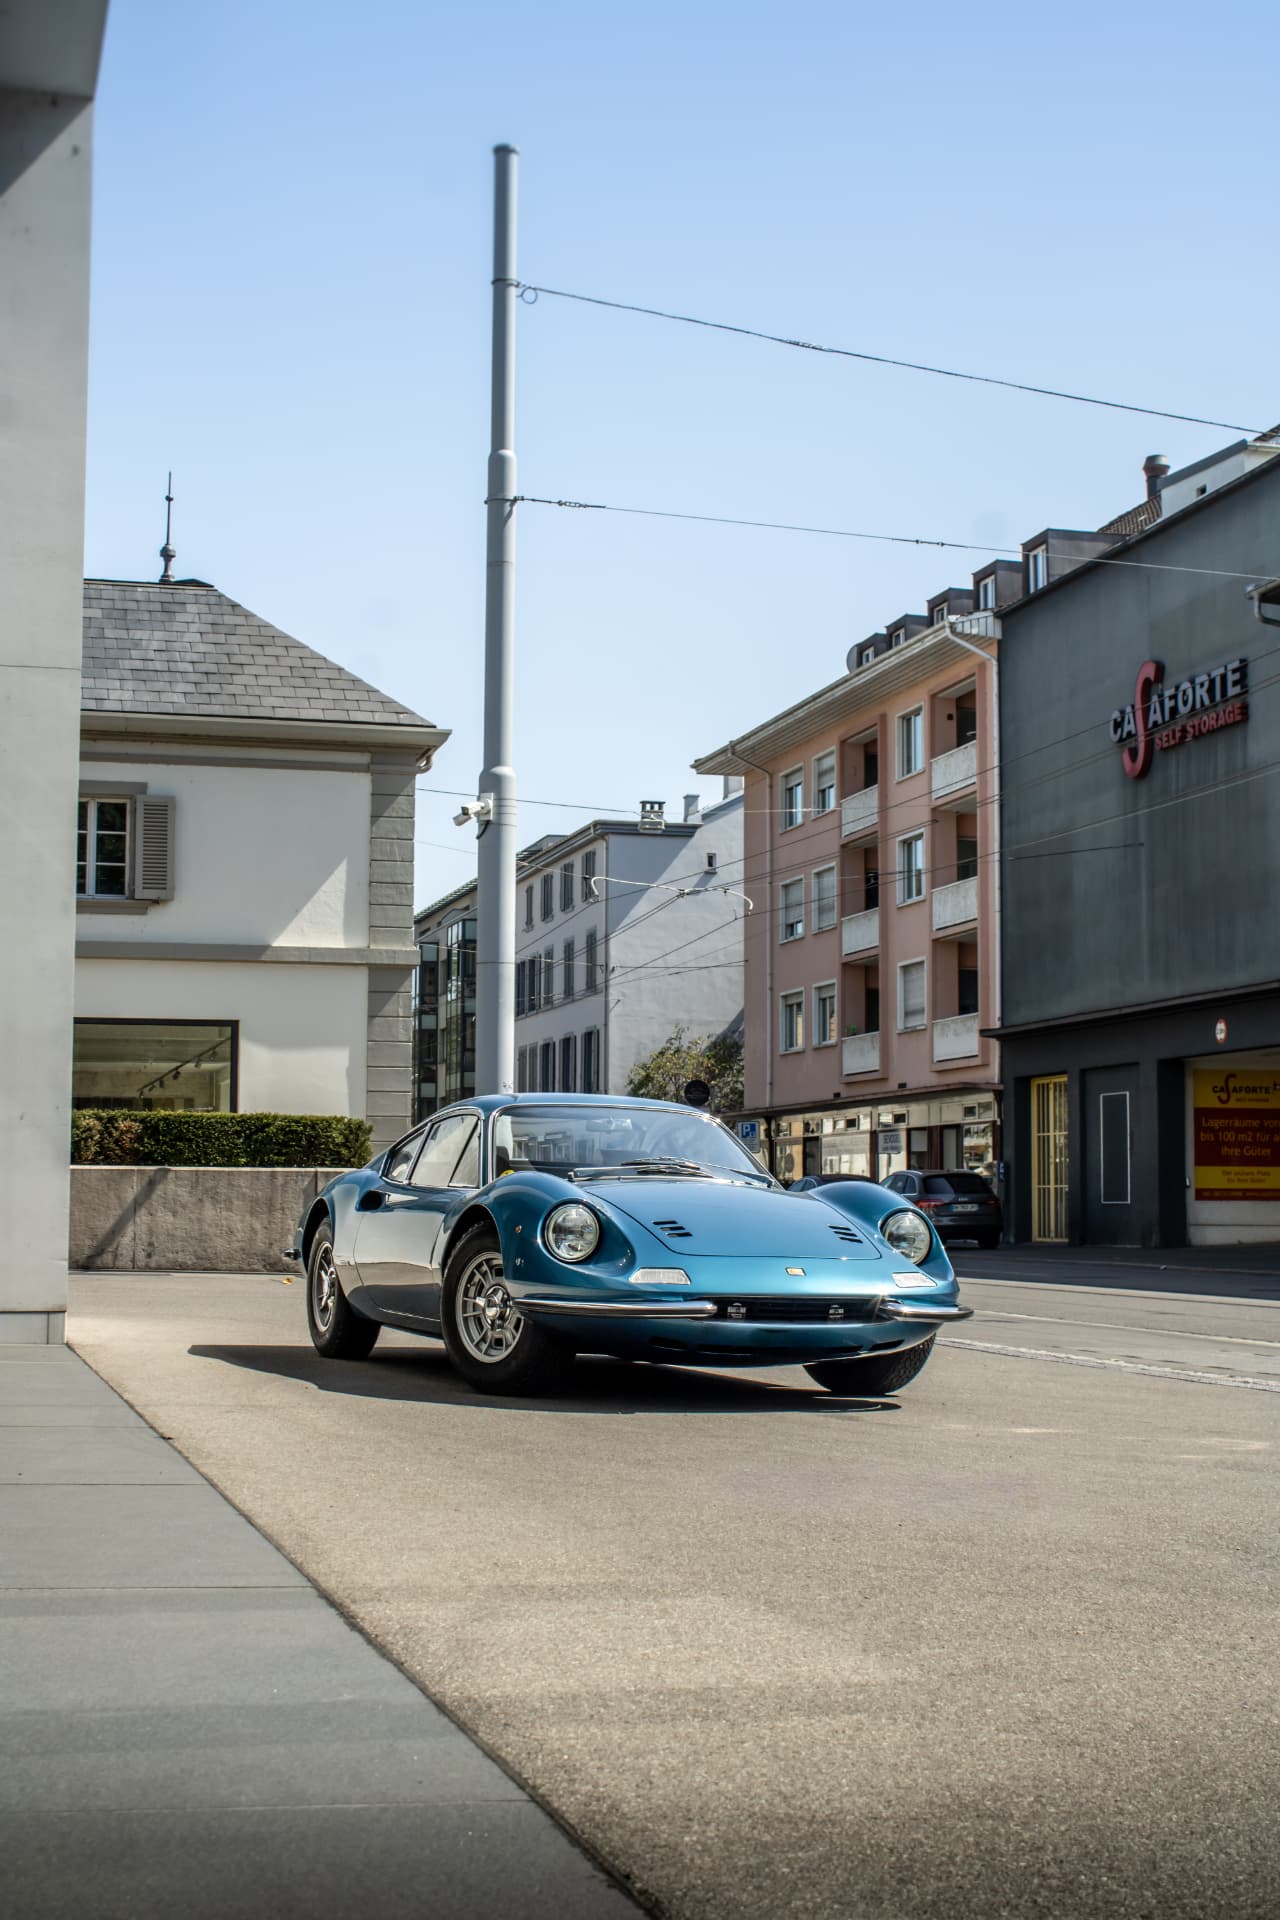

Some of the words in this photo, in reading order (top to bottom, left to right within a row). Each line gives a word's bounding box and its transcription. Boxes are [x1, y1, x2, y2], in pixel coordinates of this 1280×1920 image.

[1109, 659, 1244, 778] CASAFORTE
[1155, 727, 1184, 750] SELF
[1186, 704, 1244, 738] STORAGE
[1212, 1073, 1271, 1104] CASAFORTE
[743, 1124, 751, 1136] P
[1200, 1131, 1214, 1142] bis
[1219, 1131, 1236, 1142] 100
